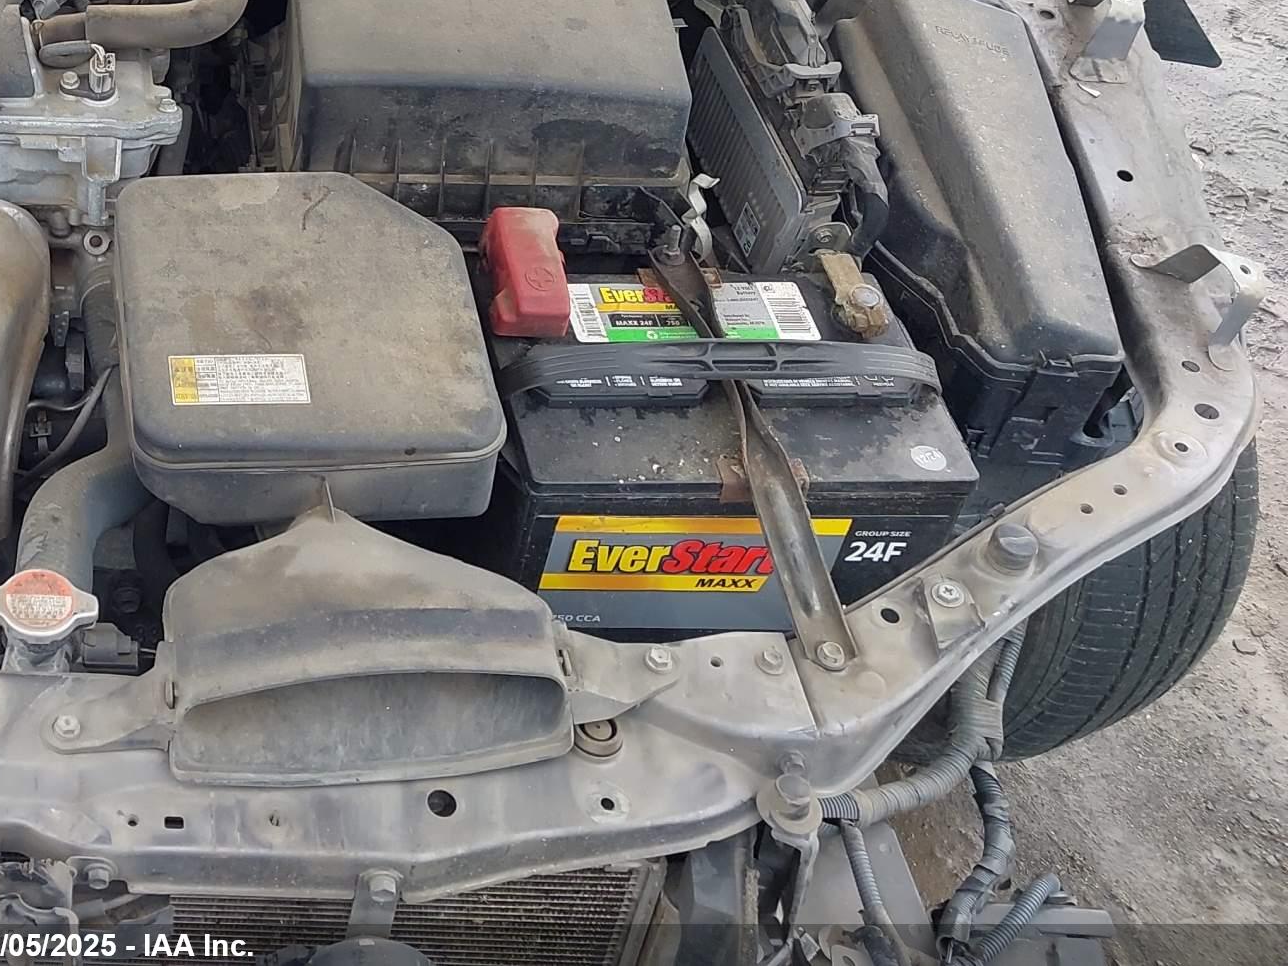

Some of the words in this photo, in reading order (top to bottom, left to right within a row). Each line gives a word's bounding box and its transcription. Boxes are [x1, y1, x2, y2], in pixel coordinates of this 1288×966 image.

[599, 287, 673, 303] EverSt
[844, 541, 908, 562] 24F
[695, 577, 758, 589] MAXX
[575, 614, 601, 622] CCA
